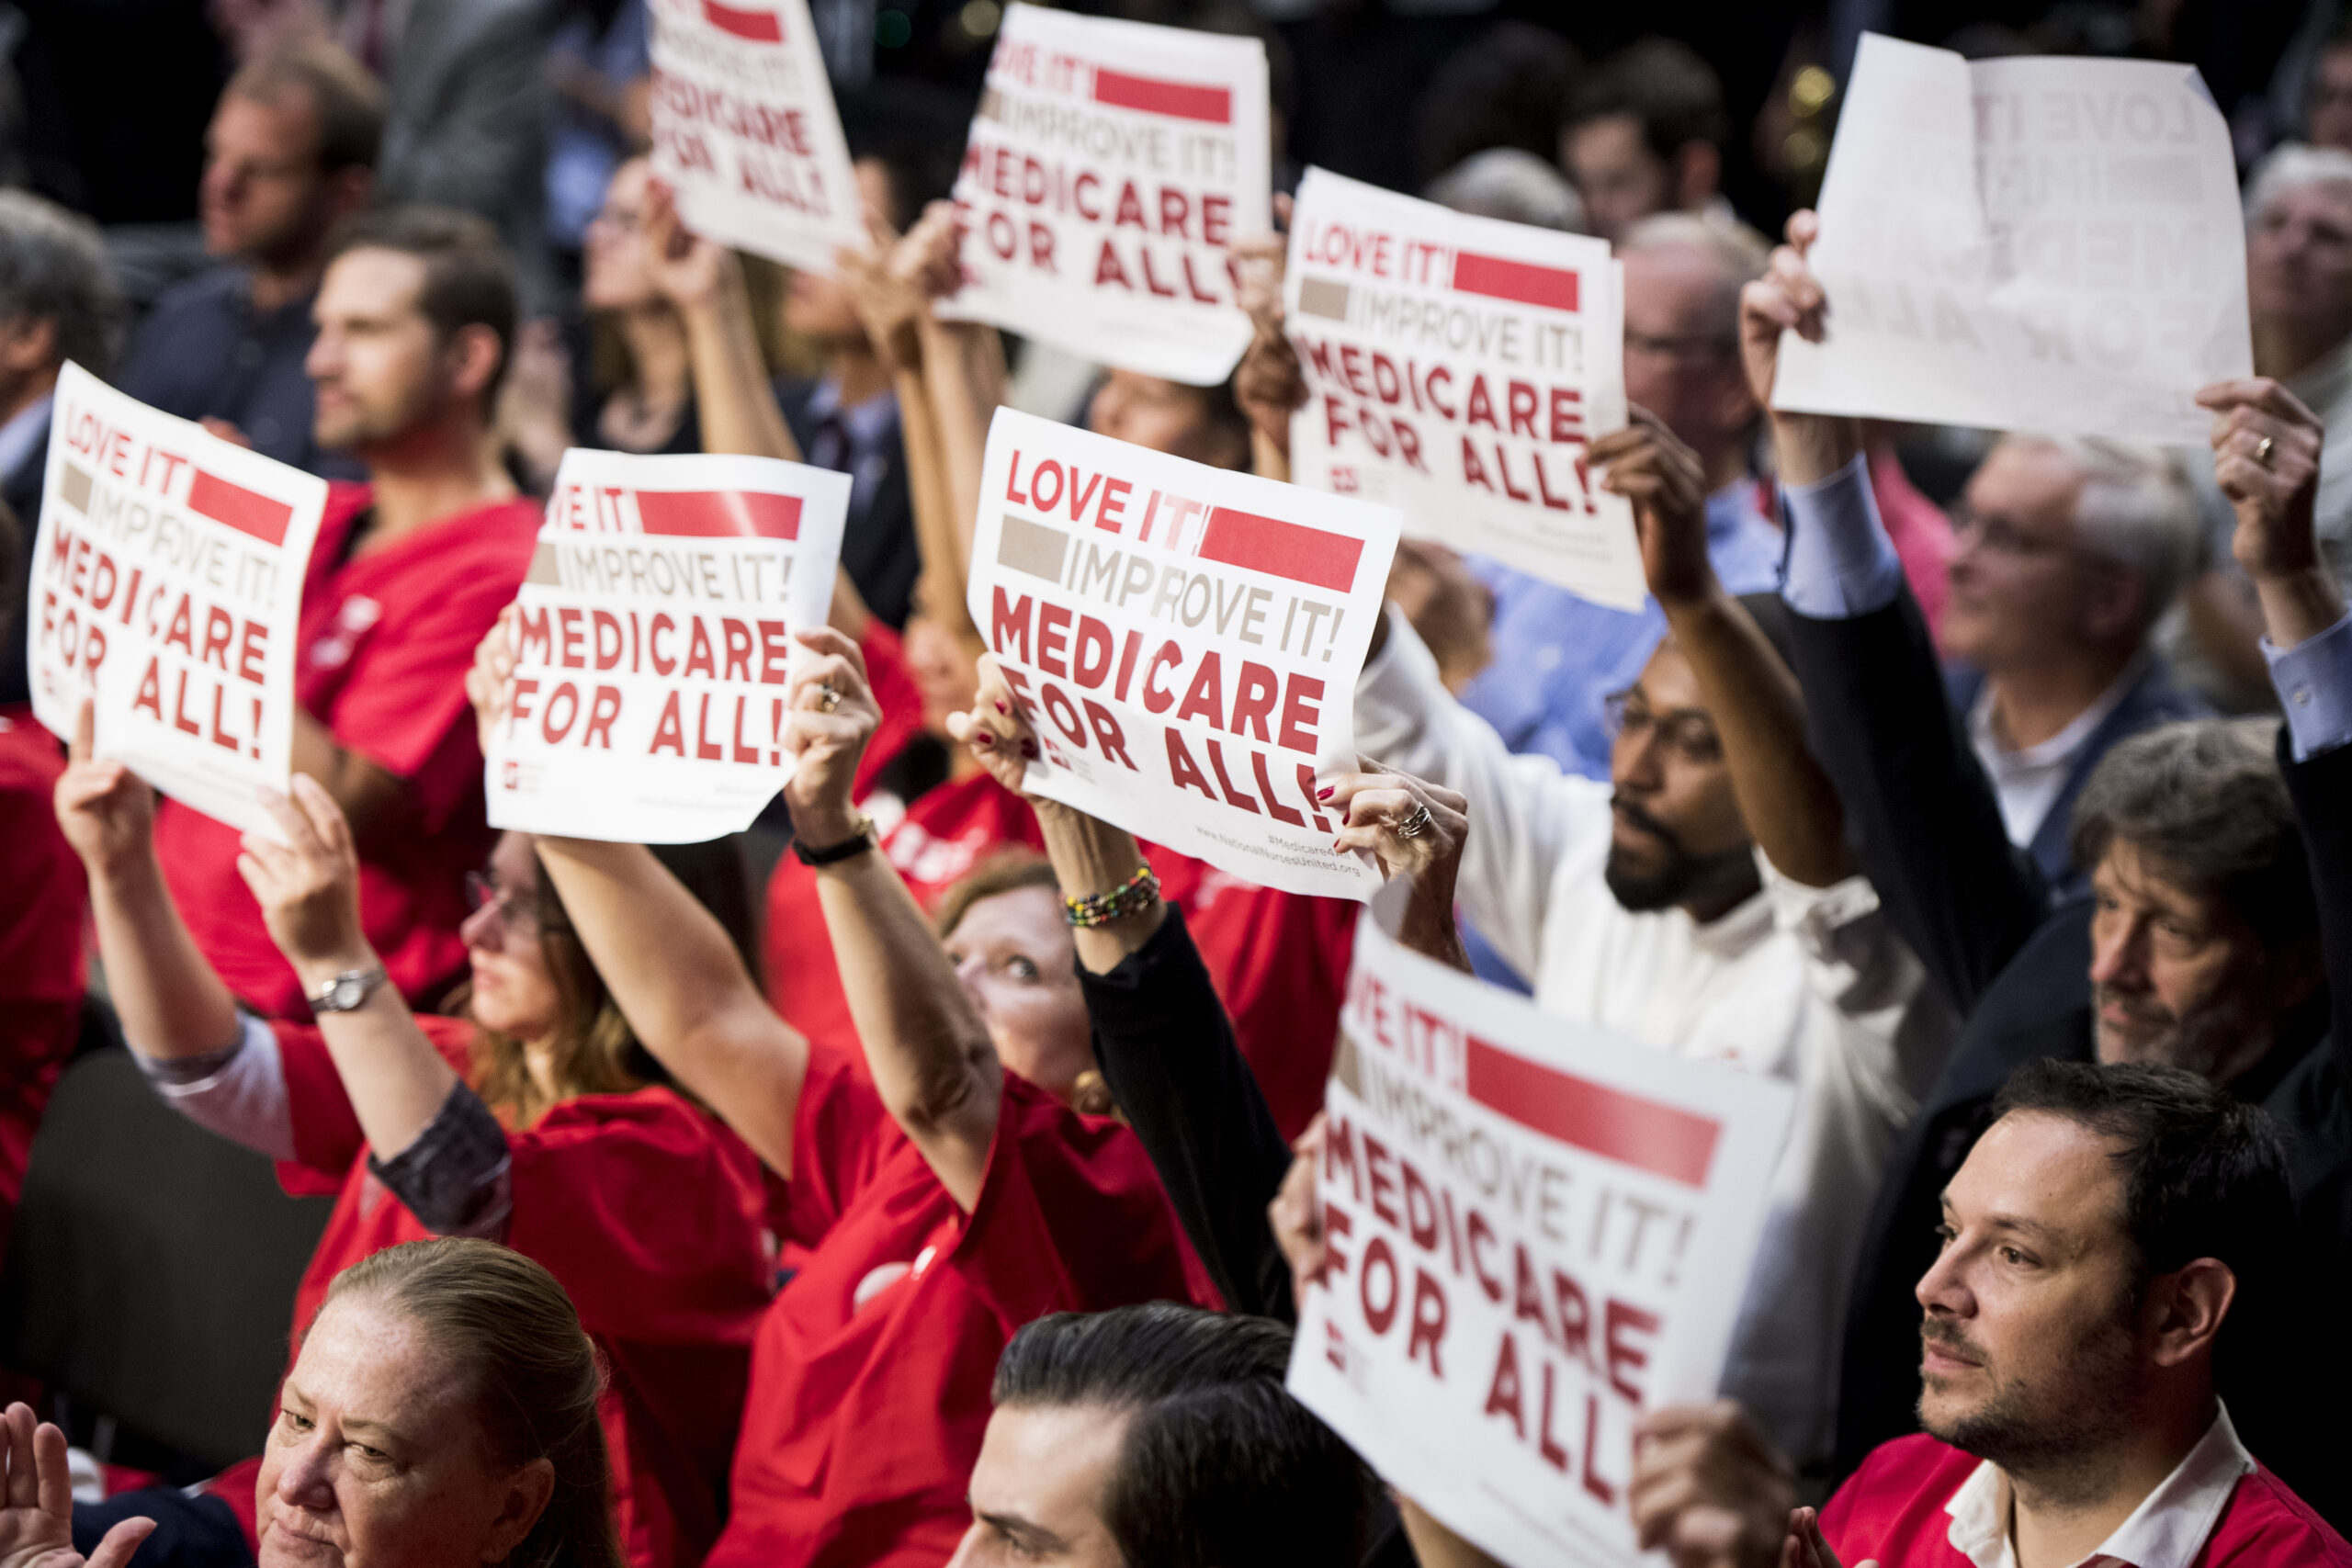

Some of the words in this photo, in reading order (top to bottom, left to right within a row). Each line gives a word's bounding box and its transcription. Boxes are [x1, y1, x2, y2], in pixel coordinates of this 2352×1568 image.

[1009, 98, 1167, 172] IMPROVE
[1180, 133, 1238, 183] IT!
[1305, 219, 1391, 276] LOVE
[1354, 286, 1523, 363] IMPROVE
[1534, 323, 1586, 374] IT!
[65, 400, 133, 479] LOVE
[1293, 333, 1587, 443] MEDICARE
[1006, 449, 1134, 535] LOVE
[1137, 489, 1211, 557] IT!
[1323, 392, 1433, 478] FOR
[1462, 434, 1599, 515] ALL!
[47, 519, 270, 687] MEDICARE
[562, 542, 725, 600] IMPROVE
[733, 552, 796, 603] IT!
[1067, 537, 1274, 646] IMPROVE
[1280, 596, 1346, 663] IT!
[41, 589, 107, 691] FOR
[132, 654, 264, 761] ALL!
[517, 604, 788, 686] MEDICARE
[992, 584, 1326, 756] MEDICARE
[509, 678, 623, 750] FOR
[647, 690, 785, 768] ALL!
[998, 664, 1141, 773] FOR
[1164, 726, 1334, 834] ALL!
[1195, 825, 1362, 878] www.NationalNursesUnited.org
[1363, 1055, 1574, 1247] IMPROVE
[1586, 1185, 1702, 1291] IT!
[1325, 1113, 1665, 1408] MEDICARE
[1324, 1200, 1449, 1382] FOR
[1483, 1331, 1644, 1509] ALL
